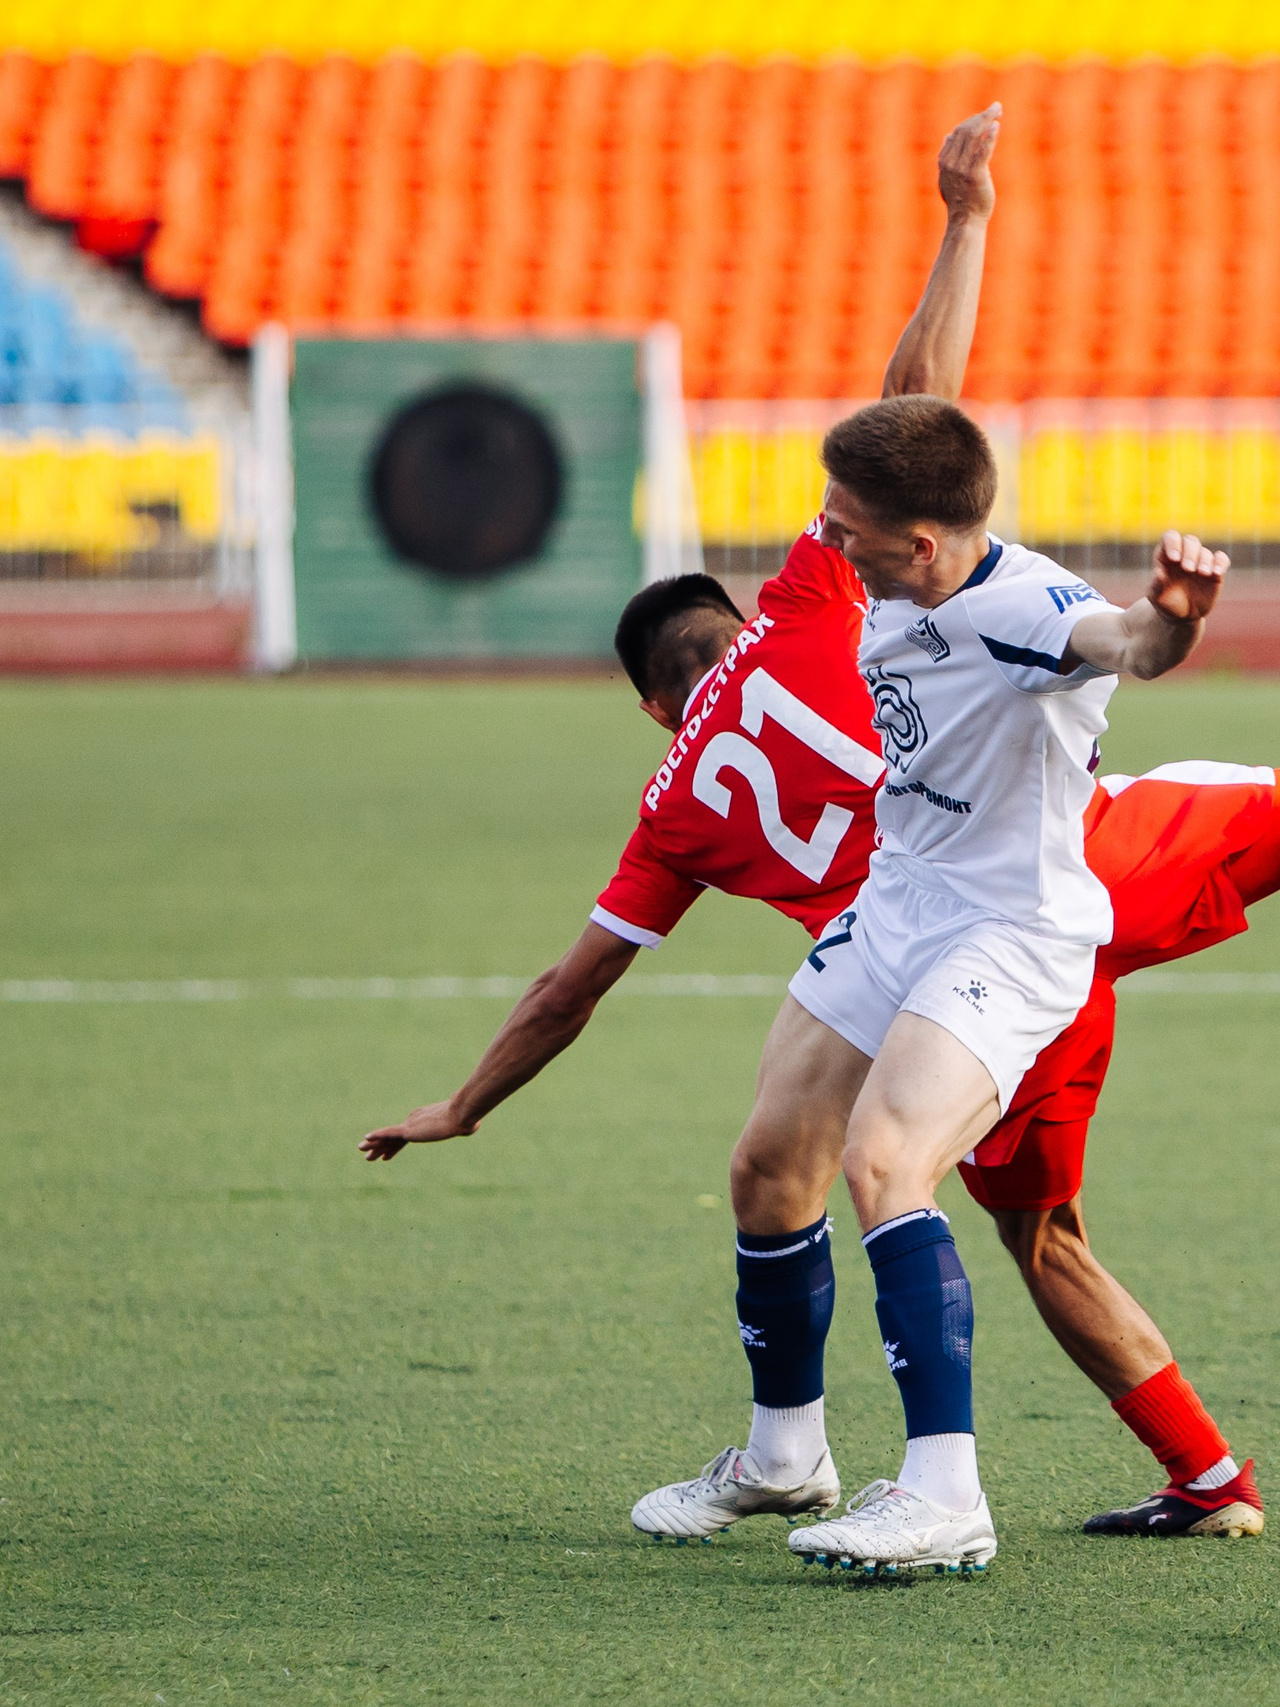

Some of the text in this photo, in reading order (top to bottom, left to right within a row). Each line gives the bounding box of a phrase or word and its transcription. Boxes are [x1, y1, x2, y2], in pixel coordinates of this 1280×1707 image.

[645, 612, 776, 812] РОСГОССТРАХ
[692, 666, 888, 885] 21
[952, 986, 986, 1016] KELME
